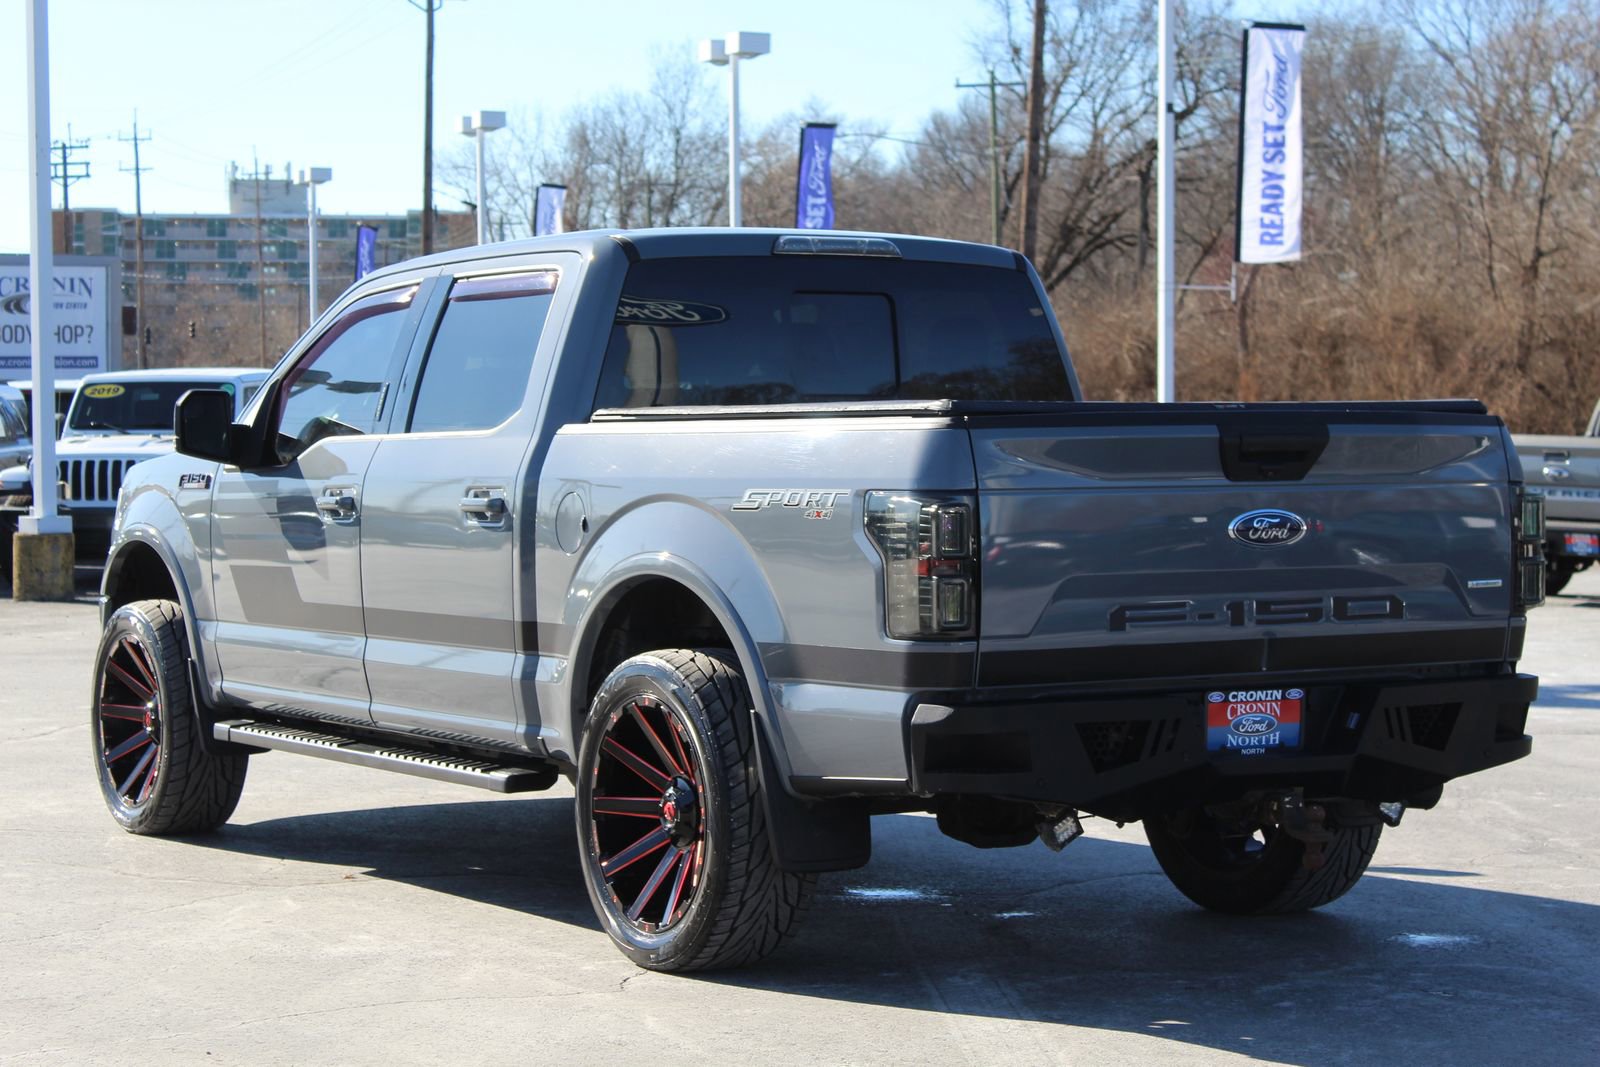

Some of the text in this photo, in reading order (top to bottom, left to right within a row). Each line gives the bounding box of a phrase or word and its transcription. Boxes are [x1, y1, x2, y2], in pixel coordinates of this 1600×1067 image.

[1259, 53, 1289, 246] READY SET Ford
[0, 276, 93, 299] CRNIN
[89, 386, 120, 396] 2019
[731, 488, 851, 511] SPORT
[1248, 517, 1291, 540] Ford
[1109, 595, 1404, 632] F-150
[1228, 690, 1282, 702] CRONIN
[1227, 702, 1280, 720] CRONIN
[1239, 717, 1268, 732] Ford
[1227, 732, 1280, 746] NORTH
